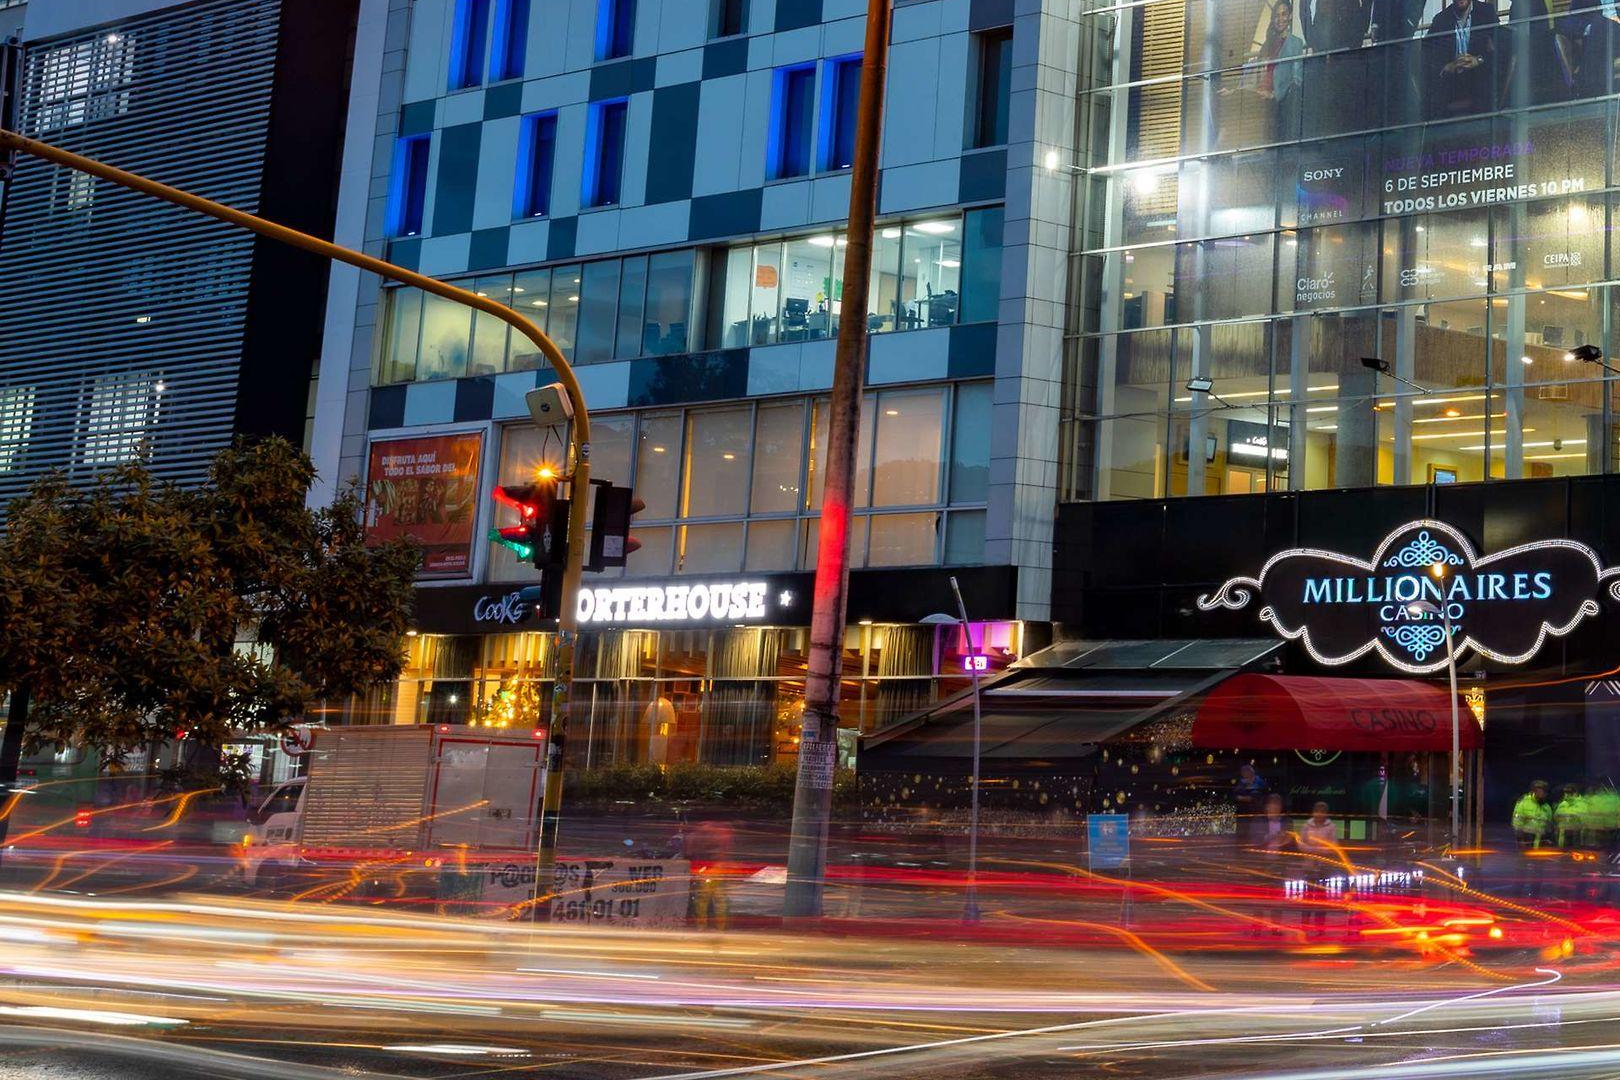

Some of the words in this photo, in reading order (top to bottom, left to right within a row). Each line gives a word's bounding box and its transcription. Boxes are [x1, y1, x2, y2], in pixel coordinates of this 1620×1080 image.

[1439, 141, 1534, 165] TEMPORADA
[1303, 167, 1344, 182] SONY
[1385, 179, 1393, 193] 6
[1398, 177, 1417, 192] DE
[1421, 164, 1515, 189] SEPTIEMBRE
[1385, 196, 1435, 214] TODOS
[1438, 192, 1467, 208] LOS
[1470, 183, 1537, 204] VIERNES
[1541, 181, 1557, 196] 10
[1562, 177, 1585, 193] PM
[1300, 209, 1343, 221] CHANNEL
[1297, 274, 1331, 291] Claro
[1296, 289, 1336, 303] negocios
[384, 466, 404, 477] TODO
[1302, 572, 1553, 604] MILLIONAIRES
[576, 582, 768, 623] ORTERHOUSE
[1351, 708, 1436, 733] CASINO
